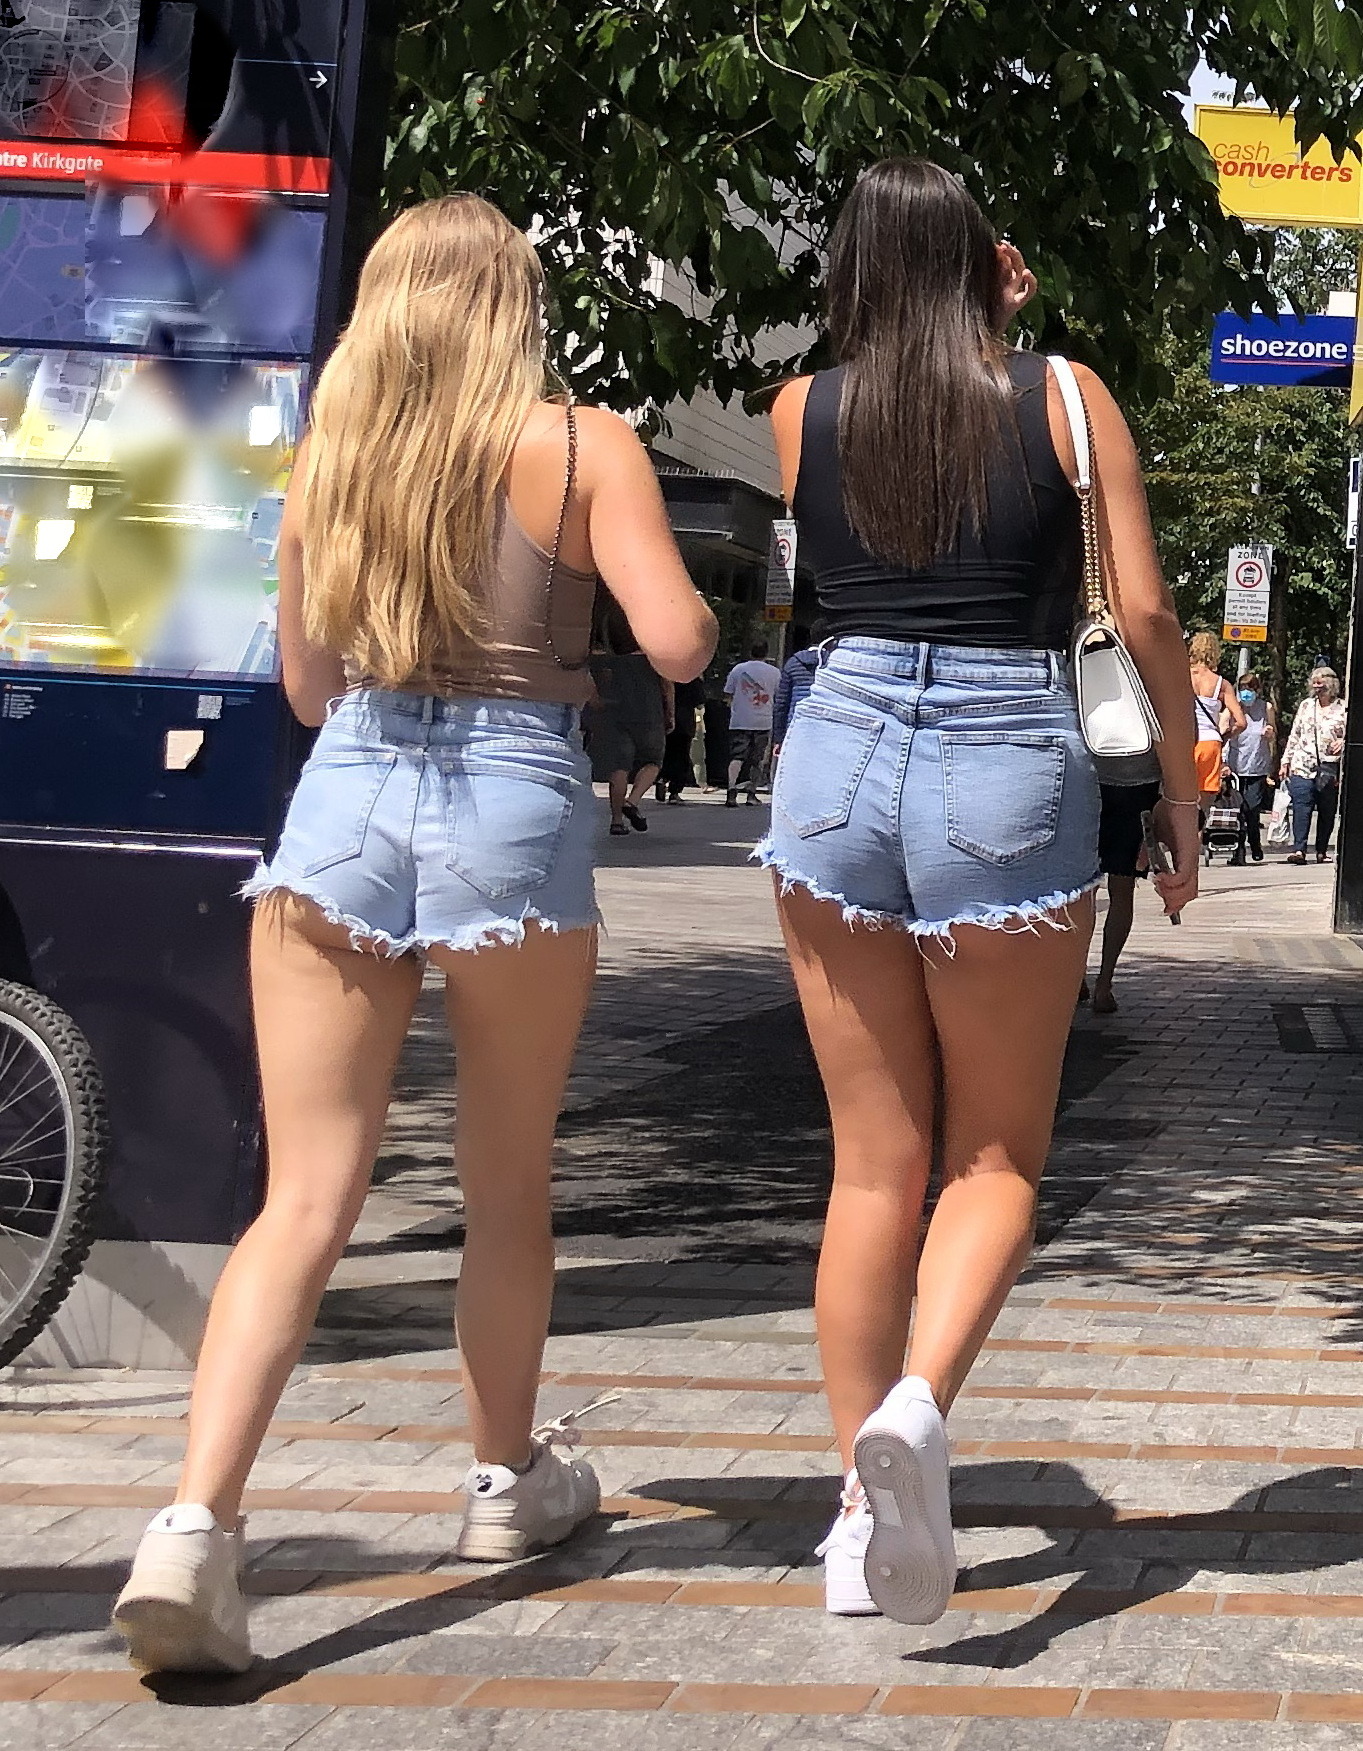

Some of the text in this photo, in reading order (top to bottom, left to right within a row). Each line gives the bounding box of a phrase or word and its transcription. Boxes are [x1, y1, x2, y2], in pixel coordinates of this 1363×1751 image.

[0, 151, 104, 173] tre Kirkgate
[1213, 141, 1270, 161] cash
[1220, 334, 1348, 359] shoezone
